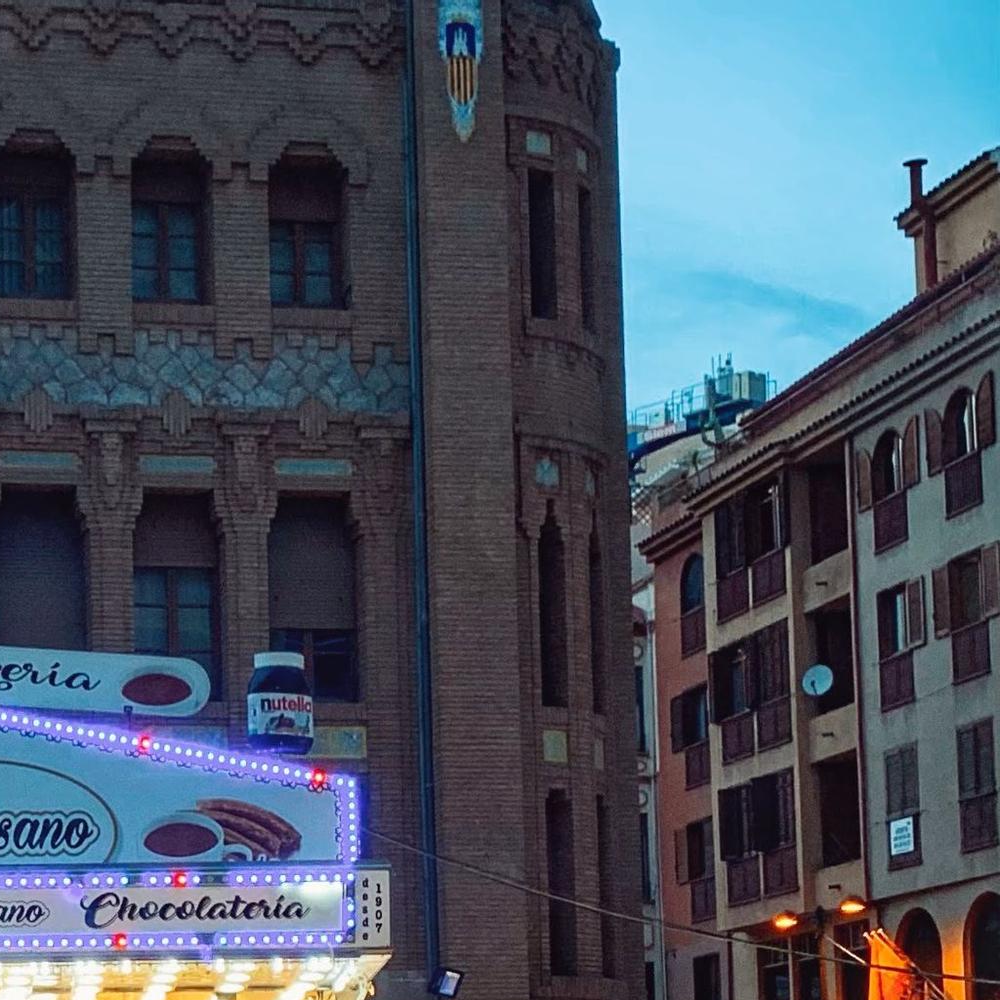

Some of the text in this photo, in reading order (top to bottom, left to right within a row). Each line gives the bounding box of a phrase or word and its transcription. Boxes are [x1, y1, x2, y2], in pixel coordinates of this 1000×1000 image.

[261, 695, 312, 713] nutella
[80, 892, 310, 929] Chocolatería
[375, 883, 383, 933] 1907
